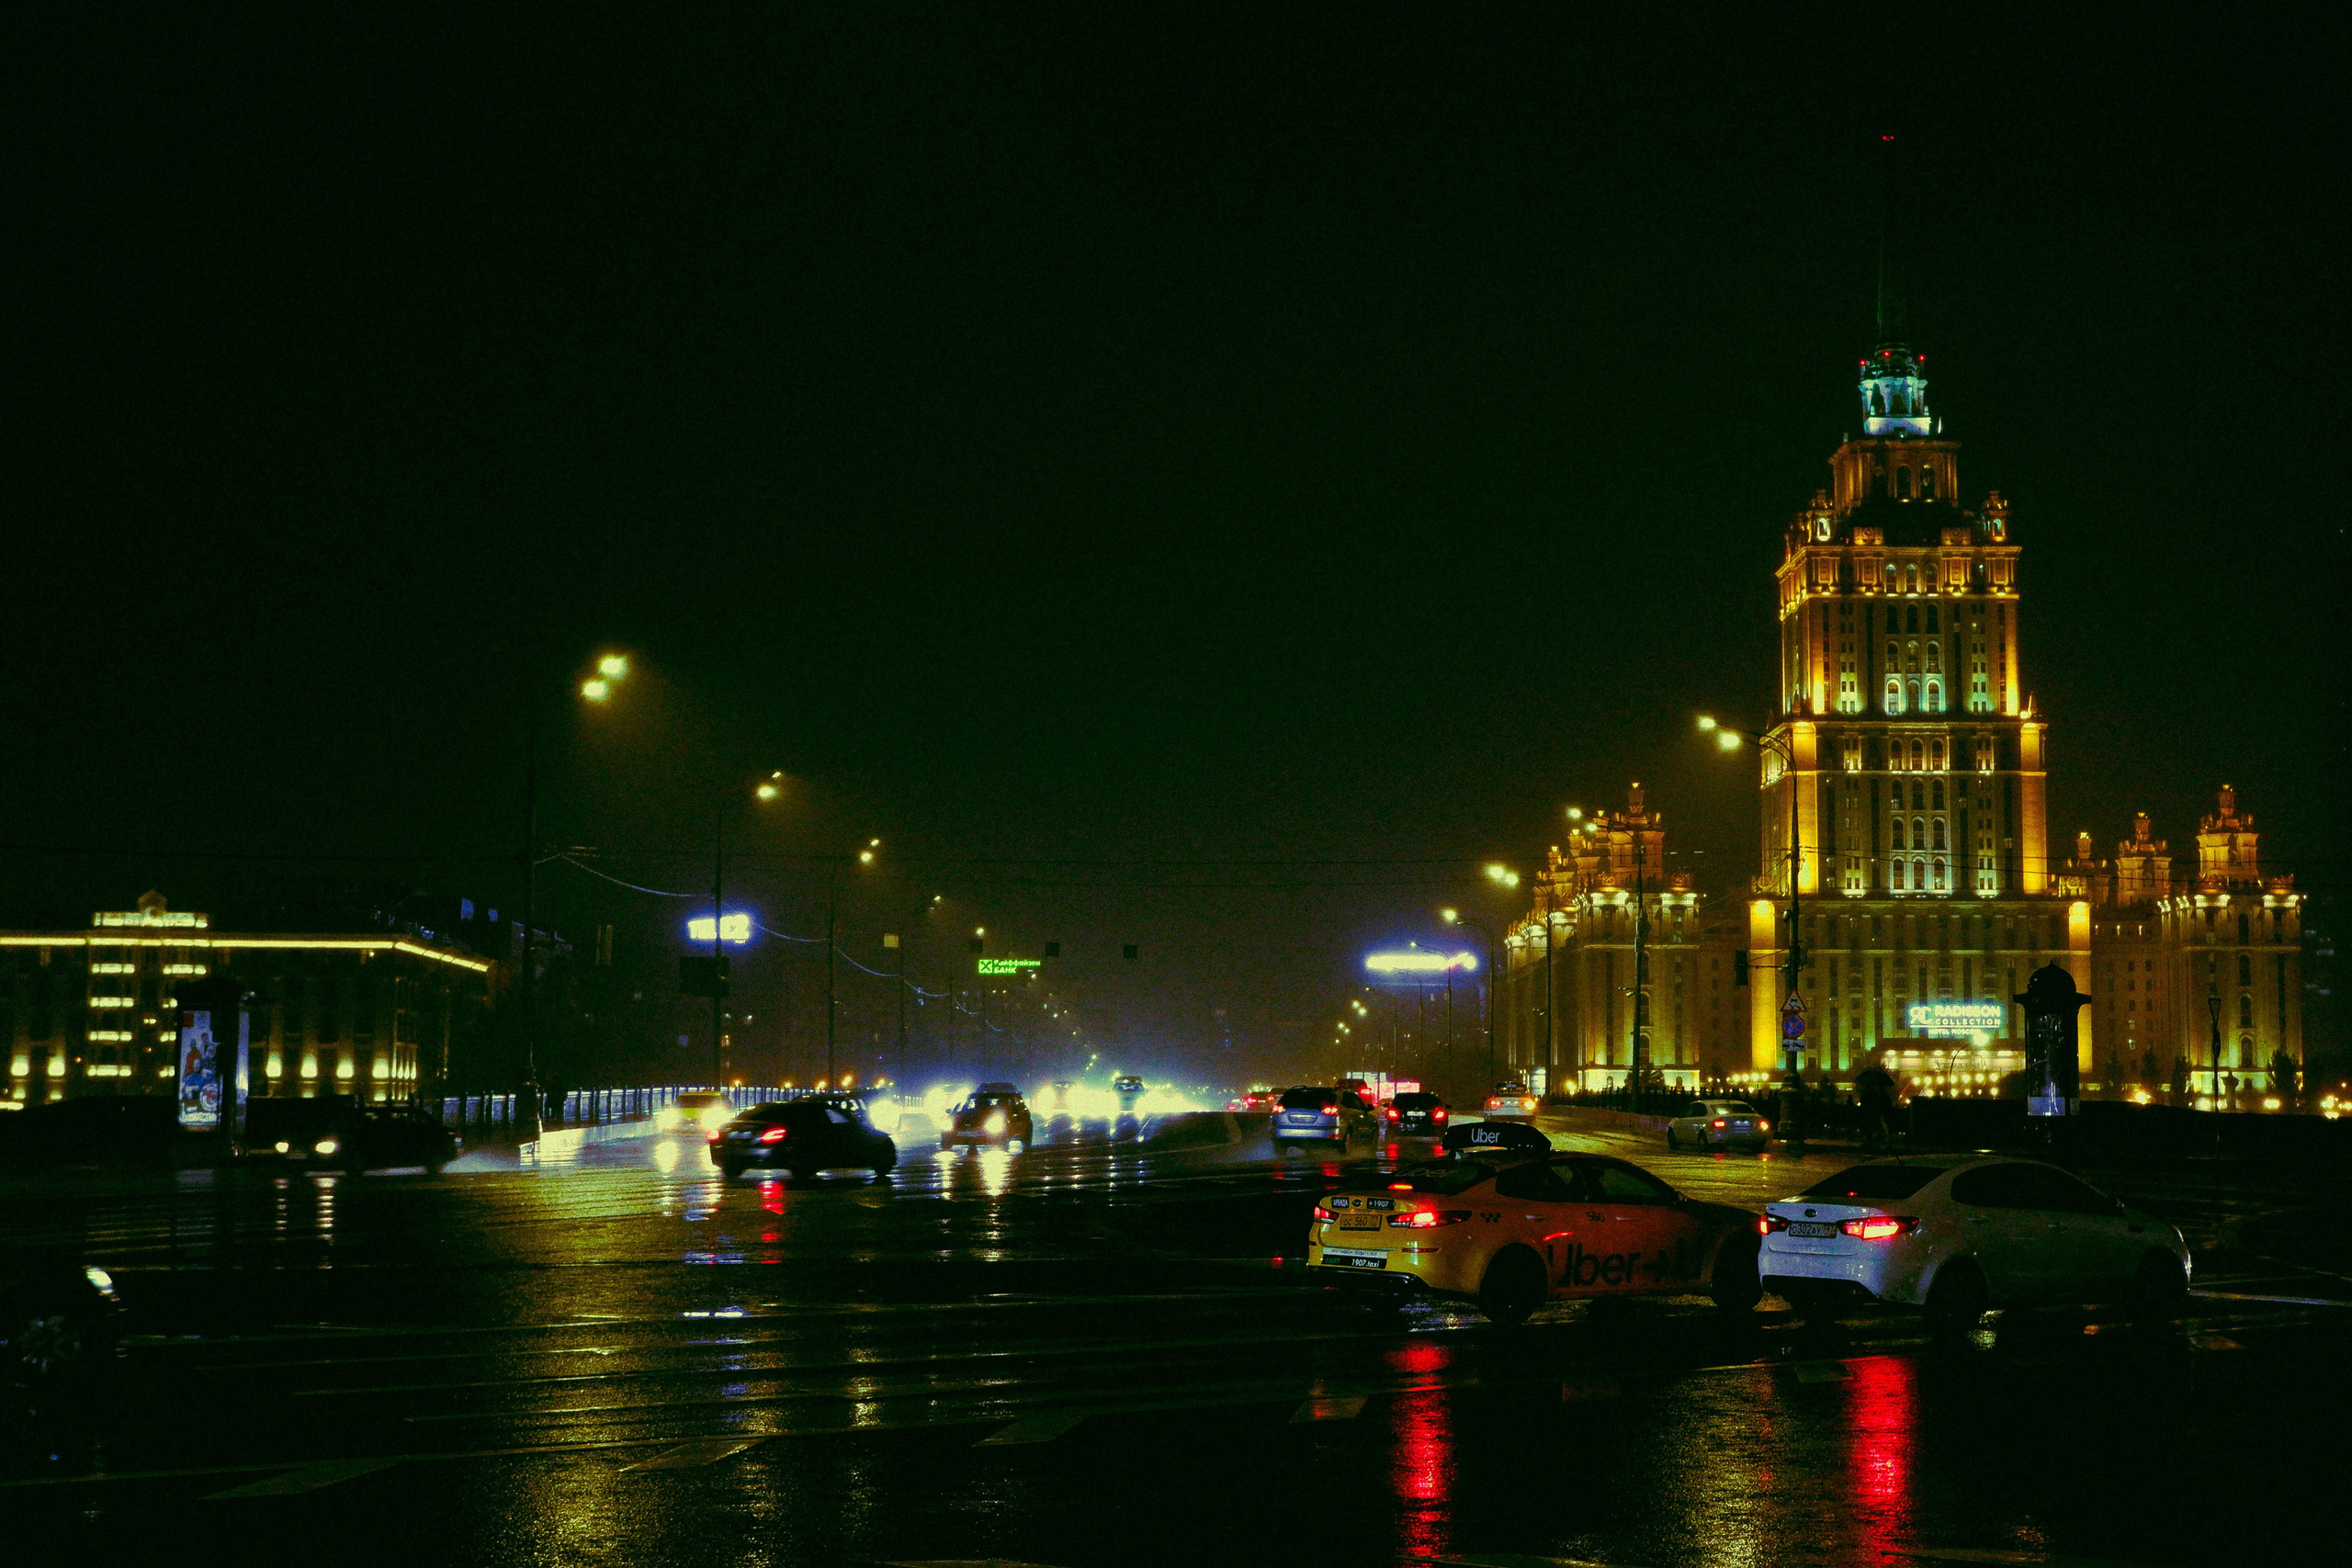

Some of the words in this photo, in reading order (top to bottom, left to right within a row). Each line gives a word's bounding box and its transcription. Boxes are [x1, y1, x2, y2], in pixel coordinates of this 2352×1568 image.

[1934, 1005, 2001, 1017] RADISSON
[1471, 1128, 1501, 1144] Uber
[1355, 1216, 1368, 1226] 560
[1587, 1212, 1606, 1223] 560
[1351, 1258, 1380, 1268] 1907.taxi
[1547, 1243, 1641, 1288] Uber
